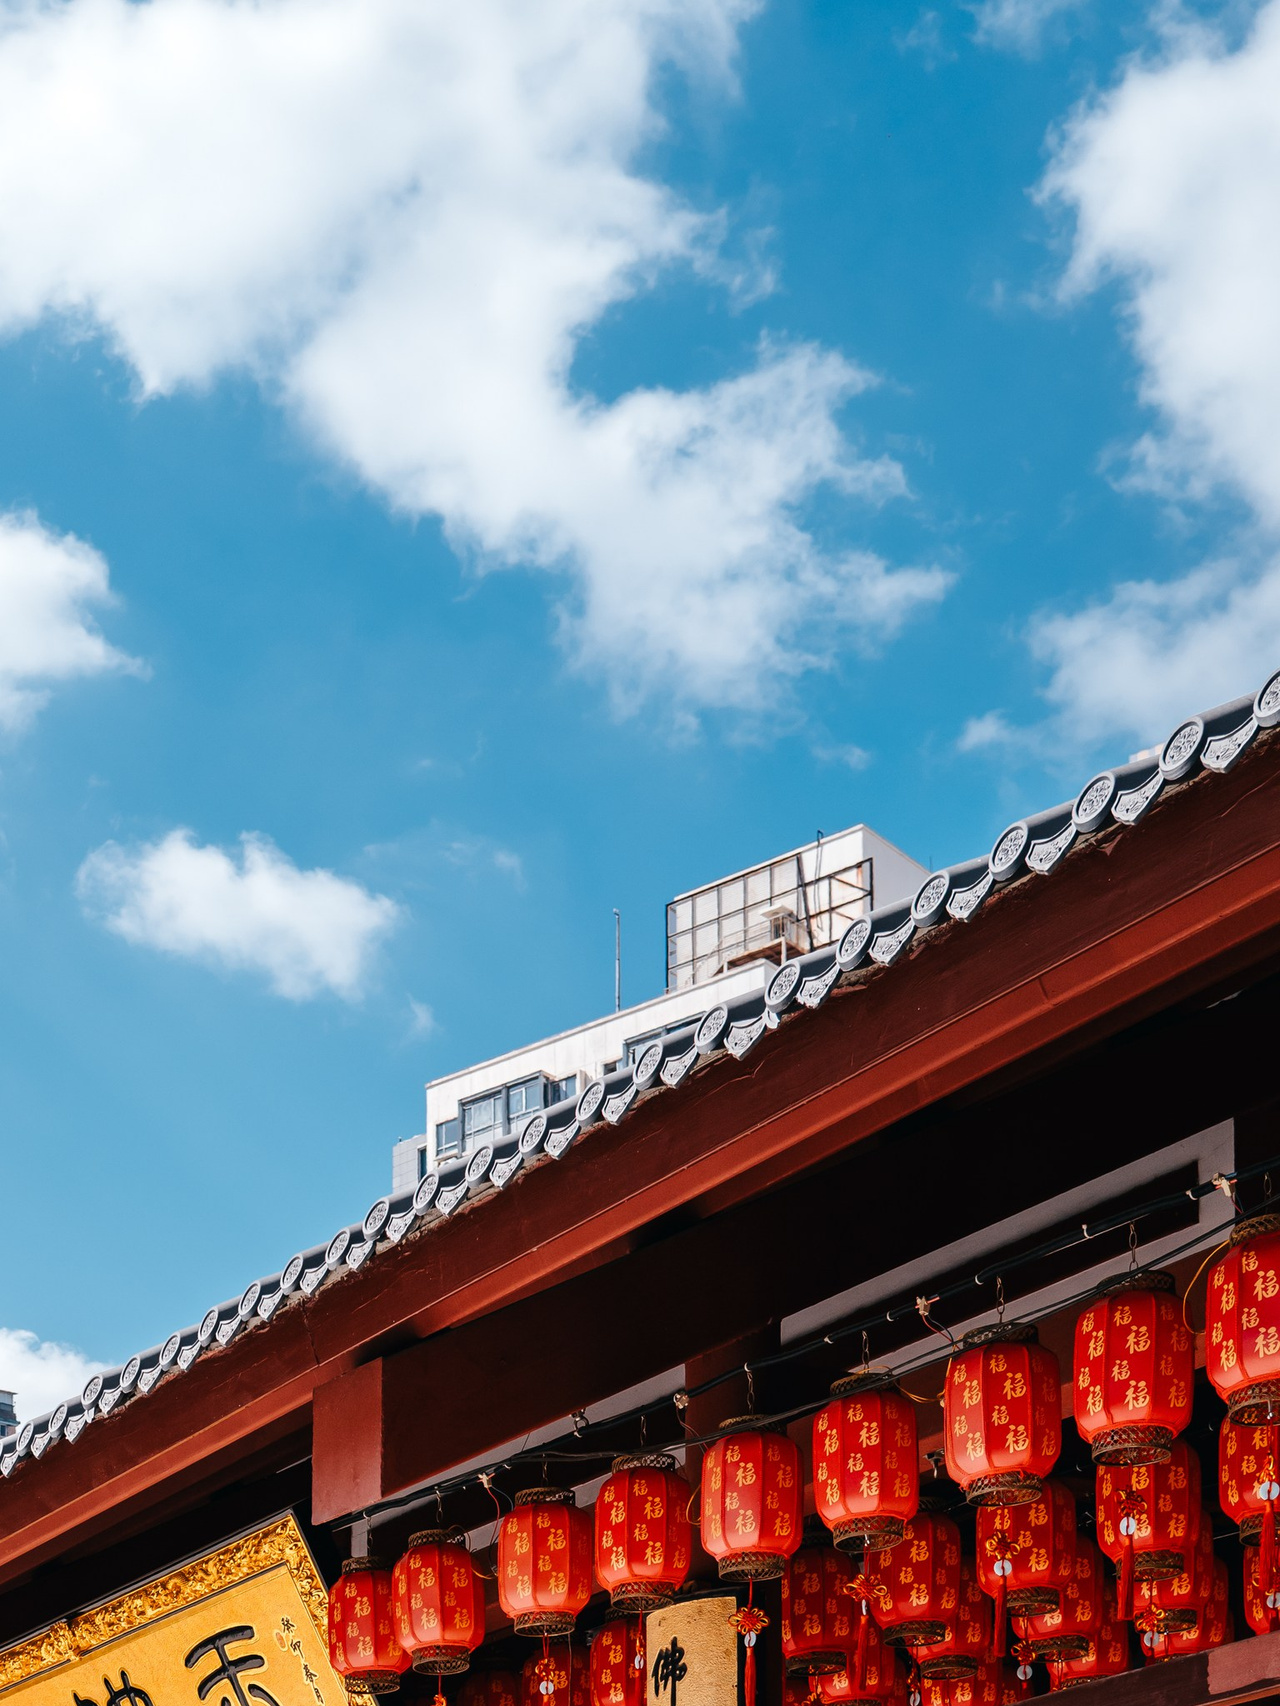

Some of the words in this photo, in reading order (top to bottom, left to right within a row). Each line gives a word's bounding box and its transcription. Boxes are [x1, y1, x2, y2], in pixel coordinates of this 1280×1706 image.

[1242, 1252, 1258, 1273] 福
[1253, 1270, 1279, 1301] 福
[1220, 1282, 1235, 1314] 福
[1082, 1313, 1095, 1335] 福
[1114, 1306, 1132, 1326] 福
[1242, 1308, 1259, 1330] 福
[1088, 1330, 1104, 1360] 福
[1126, 1326, 1150, 1354] 福
[1254, 1327, 1280, 1358] 福
[990, 1355, 1007, 1374] 福
[1160, 1355, 1174, 1376] 福
[1220, 1339, 1236, 1372] 福
[953, 1364, 966, 1383] 福
[1078, 1367, 1090, 1390] 福
[1112, 1360, 1130, 1382] 福
[963, 1379, 982, 1409] 福
[1003, 1373, 1026, 1400] 福
[1124, 1380, 1150, 1410] 福
[1168, 1379, 1187, 1408] 福
[1087, 1385, 1104, 1416] 福
[847, 1404, 863, 1422] 福
[992, 1406, 1009, 1426] 福
[859, 1422, 879, 1448] 福
[895, 1422, 911, 1447] 福
[953, 1415, 968, 1436] 福
[824, 1429, 839, 1456] 福
[966, 1431, 986, 1462] 福
[1005, 1425, 1029, 1453] 福
[1042, 1429, 1056, 1456] 福
[726, 1446, 740, 1463] 福
[847, 1453, 864, 1472] 福
[885, 1450, 898, 1469] 福
[1241, 1455, 1257, 1475] 福
[735, 1462, 756, 1487] 福
[776, 1464, 793, 1488] 福
[859, 1471, 879, 1498] 福
[894, 1472, 910, 1498] 福
[1132, 1467, 1149, 1491] 福
[1168, 1466, 1186, 1490] 福
[633, 1480, 648, 1496] 福
[826, 1478, 840, 1506] 福
[644, 1496, 664, 1520] 福
[725, 1492, 739, 1511] 福
[766, 1491, 779, 1509] 福
[1158, 1494, 1172, 1512] 福
[537, 1513, 550, 1528] 福
[610, 1501, 625, 1525] 福
[735, 1509, 756, 1535] 福
[773, 1512, 791, 1536] 福
[1028, 1504, 1048, 1526] 福
[506, 1518, 518, 1534] 福
[634, 1524, 648, 1541] 福
[711, 1512, 723, 1540] 福
[901, 1526, 914, 1541] 福
[1167, 1513, 1186, 1538] 福
[514, 1532, 530, 1555] 福
[547, 1528, 566, 1551] 福
[1017, 1531, 1033, 1549] 福
[409, 1555, 422, 1570] 福
[611, 1546, 628, 1571] 福
[644, 1541, 663, 1566] 福
[673, 1546, 686, 1568] 福
[878, 1549, 892, 1568] 福
[910, 1540, 929, 1563] 福
[1028, 1548, 1049, 1572] 福
[538, 1555, 552, 1572] 福
[418, 1568, 435, 1589] 福
[452, 1567, 468, 1588] 福
[548, 1570, 568, 1596] 福
[899, 1567, 914, 1584] 福
[1171, 1573, 1190, 1596] 福
[345, 1583, 357, 1598] 福
[517, 1574, 532, 1600] 福
[576, 1583, 589, 1608] 福
[909, 1584, 929, 1606] 福
[940, 1587, 955, 1609] 福
[354, 1597, 371, 1618] 福
[411, 1593, 423, 1610] 福
[444, 1591, 456, 1607] 福
[421, 1608, 439, 1631] 福
[454, 1608, 470, 1629] 福
[1075, 1600, 1092, 1622] 福
[347, 1622, 359, 1638] 福
[803, 1615, 821, 1636] 福
[966, 1624, 981, 1641] 福
[357, 1636, 374, 1659] 福
[387, 1635, 403, 1657] 福
[608, 1645, 623, 1665] 福
[552, 1671, 568, 1691] 福
[832, 1671, 848, 1689] 福
[866, 1667, 878, 1686] 福
[608, 1683, 624, 1703] 福
[930, 1686, 942, 1706] 福
[955, 1683, 972, 1702] 福
